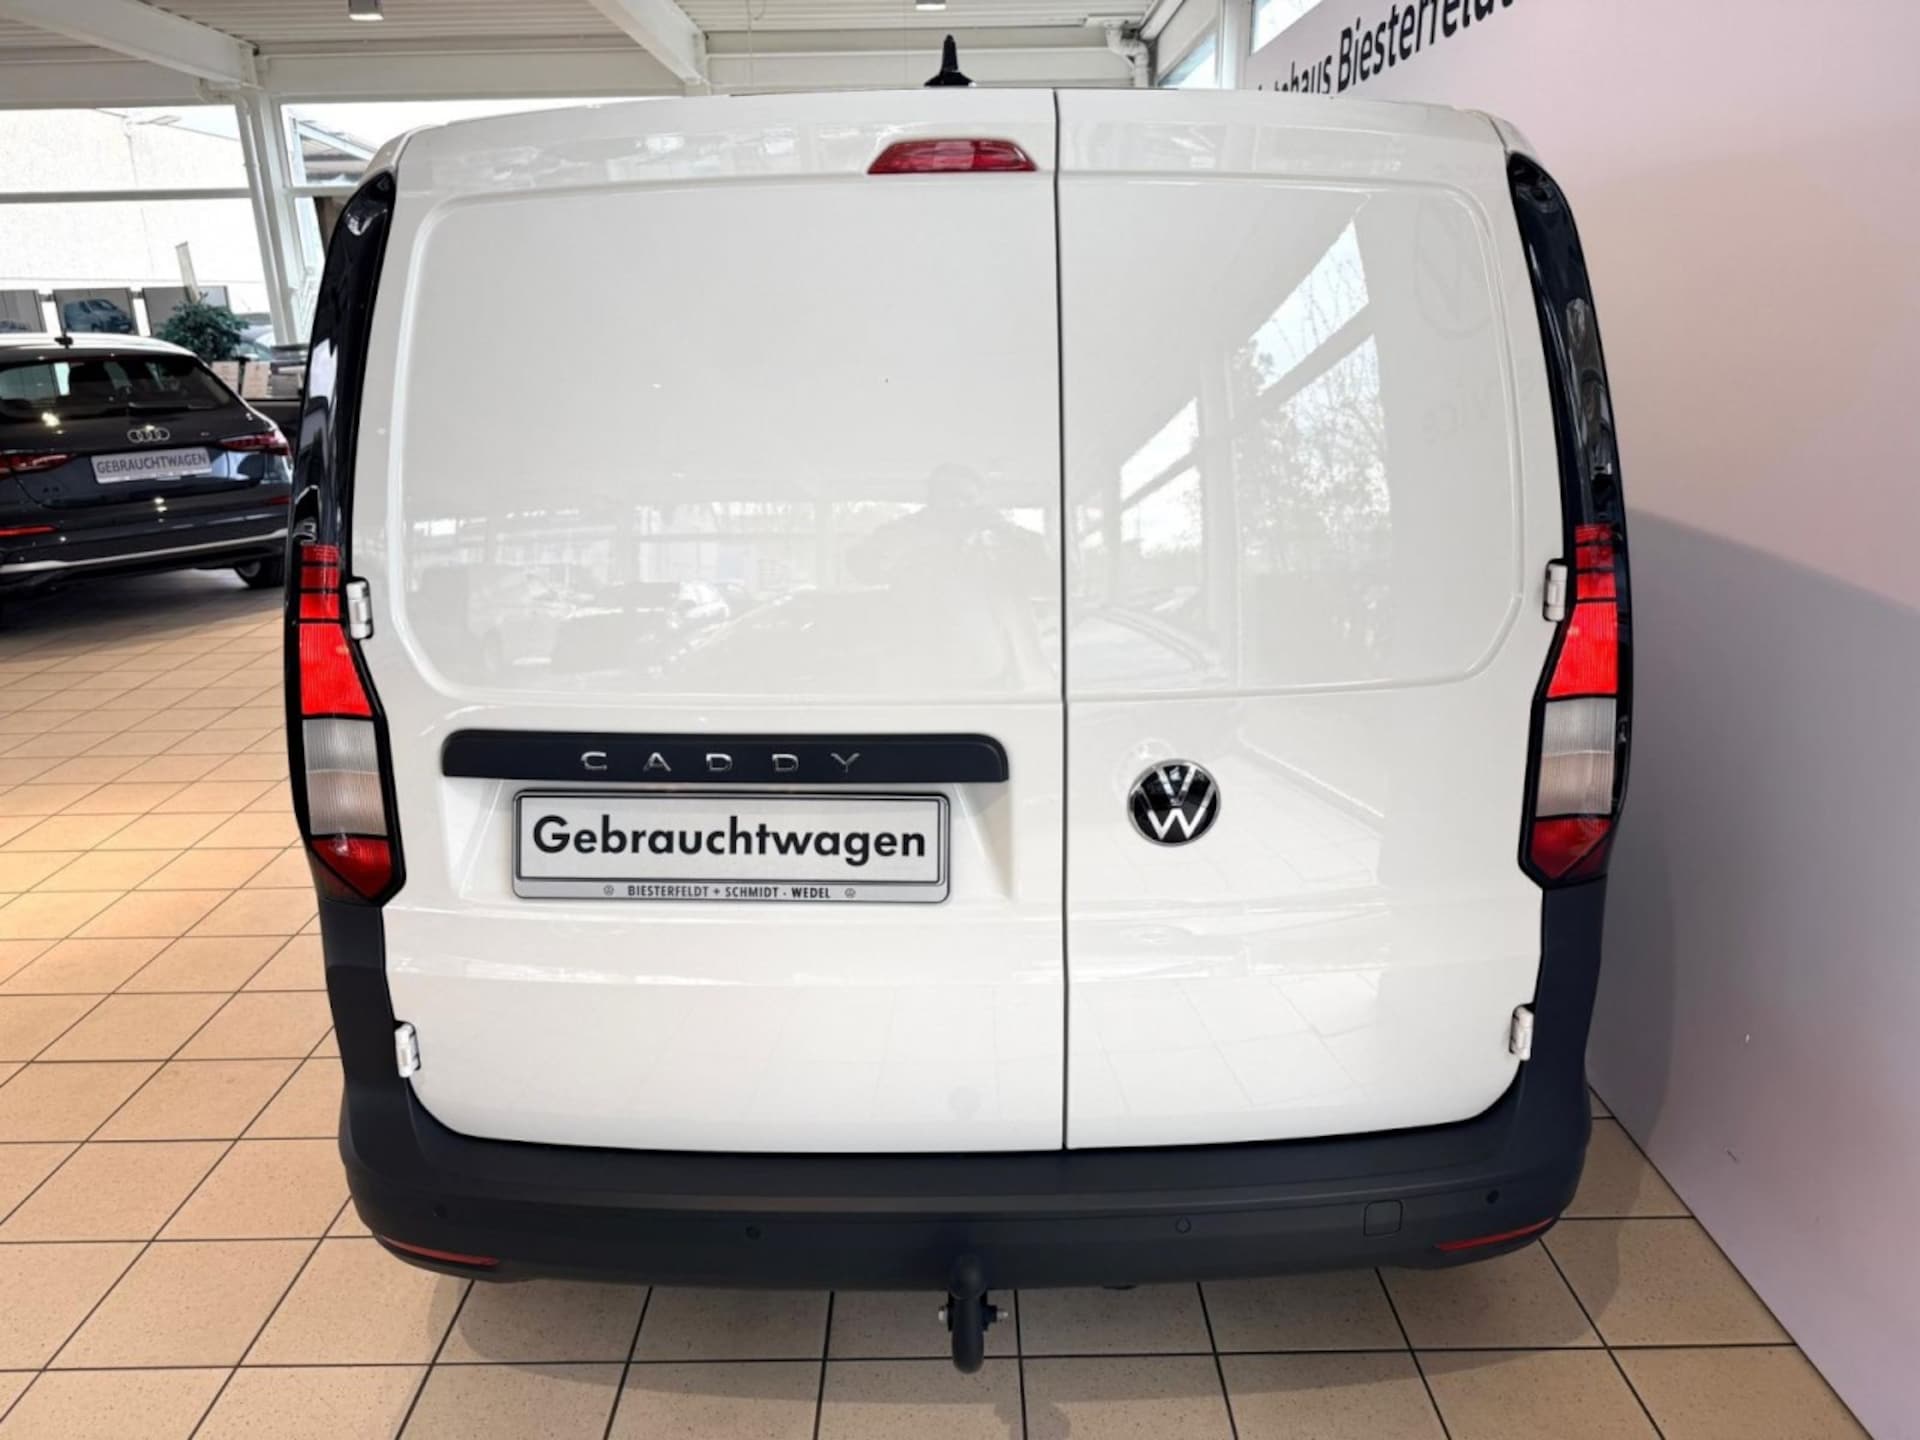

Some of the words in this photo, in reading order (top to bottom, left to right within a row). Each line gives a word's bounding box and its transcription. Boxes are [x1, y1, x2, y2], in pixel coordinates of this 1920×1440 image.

[96, 454, 207, 474] GEBRAUCHTWAGEN
[580, 751, 861, 773] CADDY
[533, 814, 926, 867] Gebrauchtwagen
[627, 884, 709, 898] BIESTERFELDT
[725, 886, 779, 899] SCHMIDT
[791, 887, 831, 899] WEDEL
